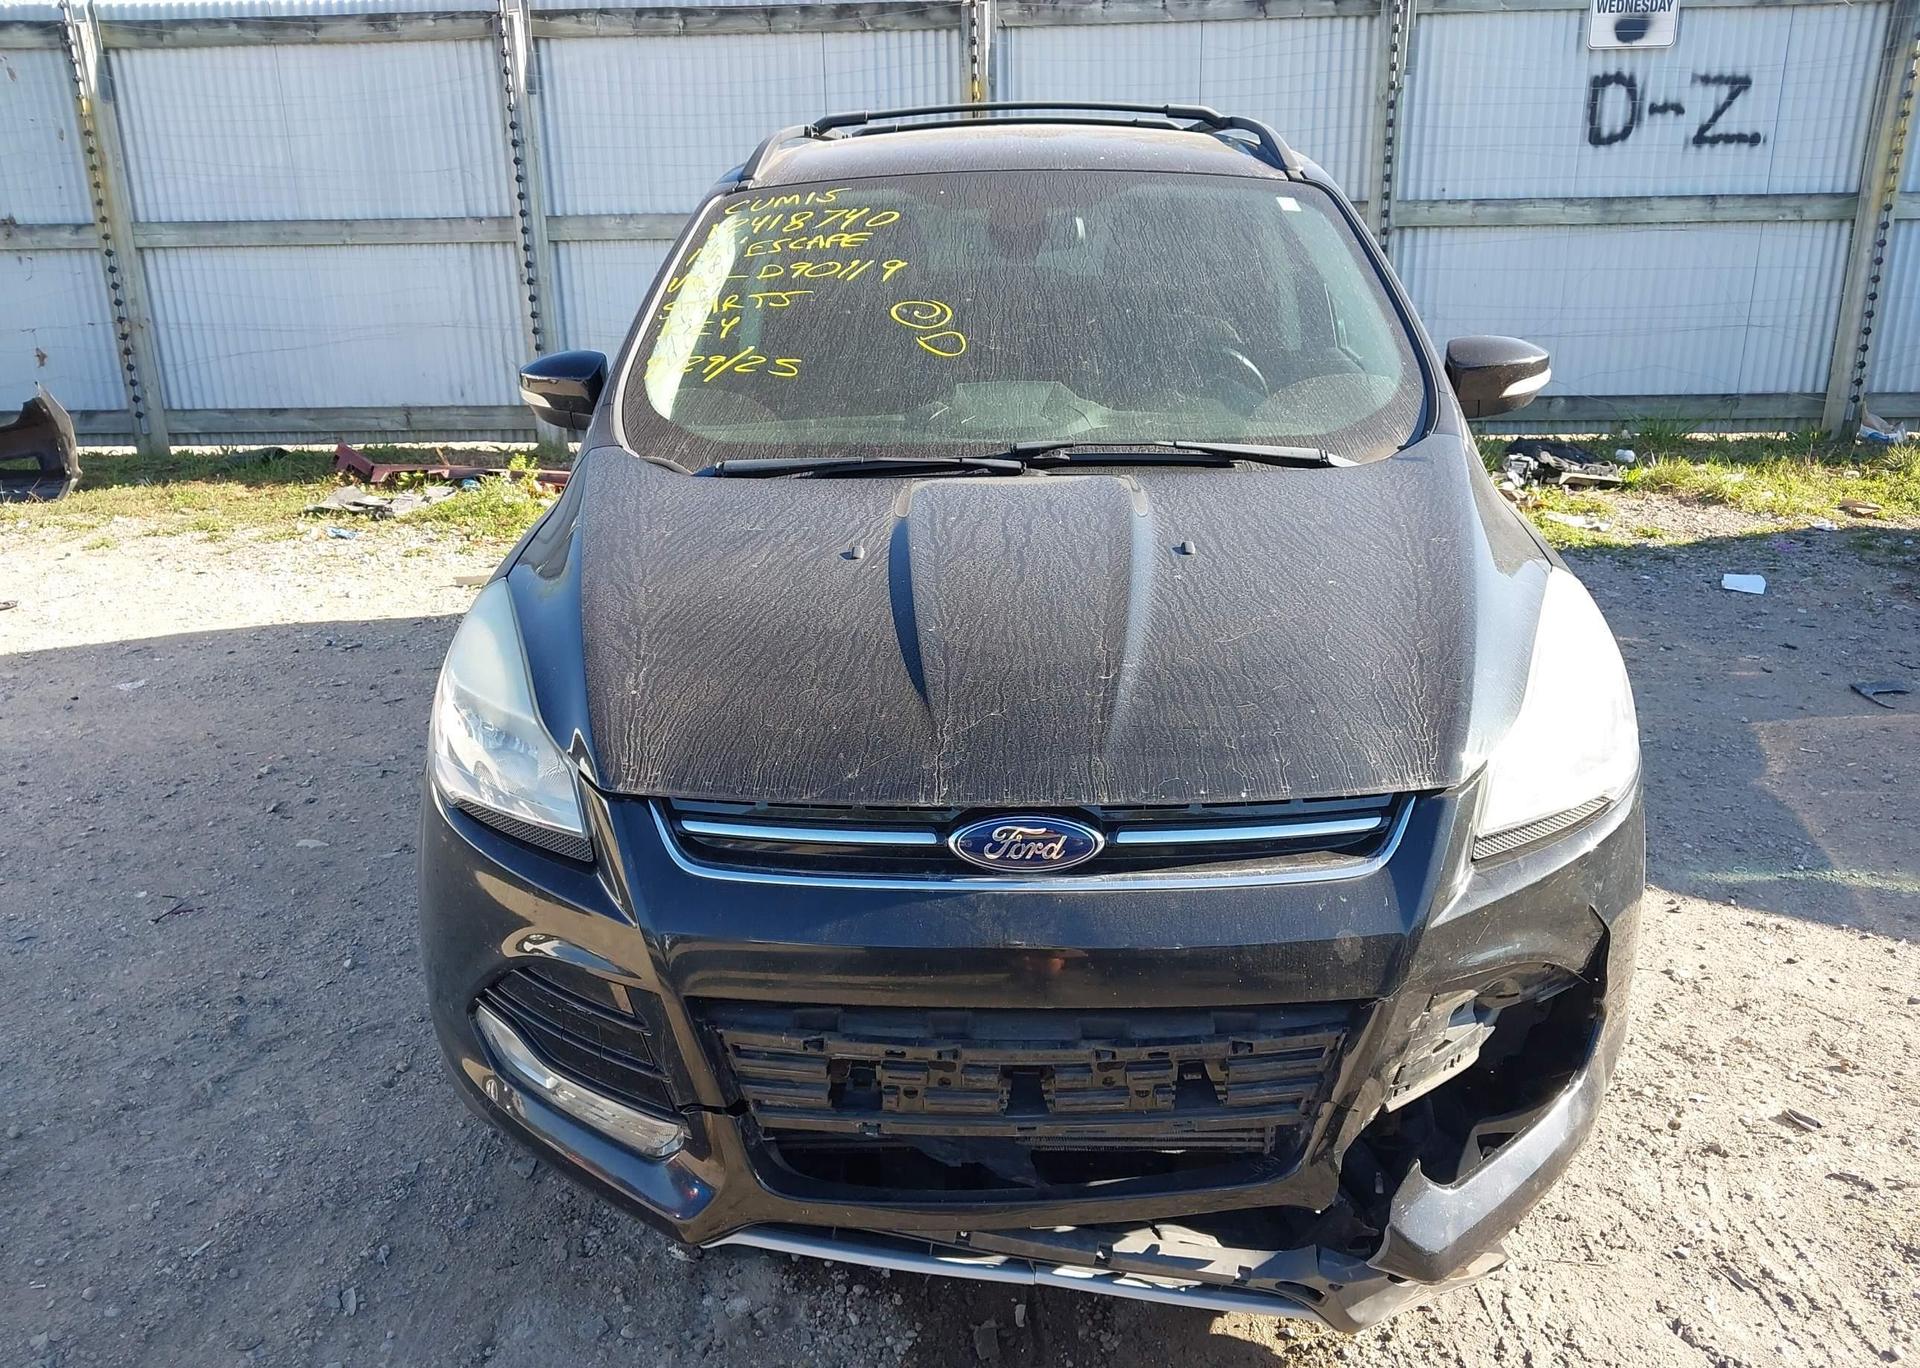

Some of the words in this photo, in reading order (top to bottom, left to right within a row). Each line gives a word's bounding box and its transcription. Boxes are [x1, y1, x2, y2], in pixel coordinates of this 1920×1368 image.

[1597, 0, 1674, 13] WEDNESDAY
[1588, 71, 1762, 146] D-Z
[744, 232, 874, 257] ESCAPE
[983, 825, 1068, 860] Ford
